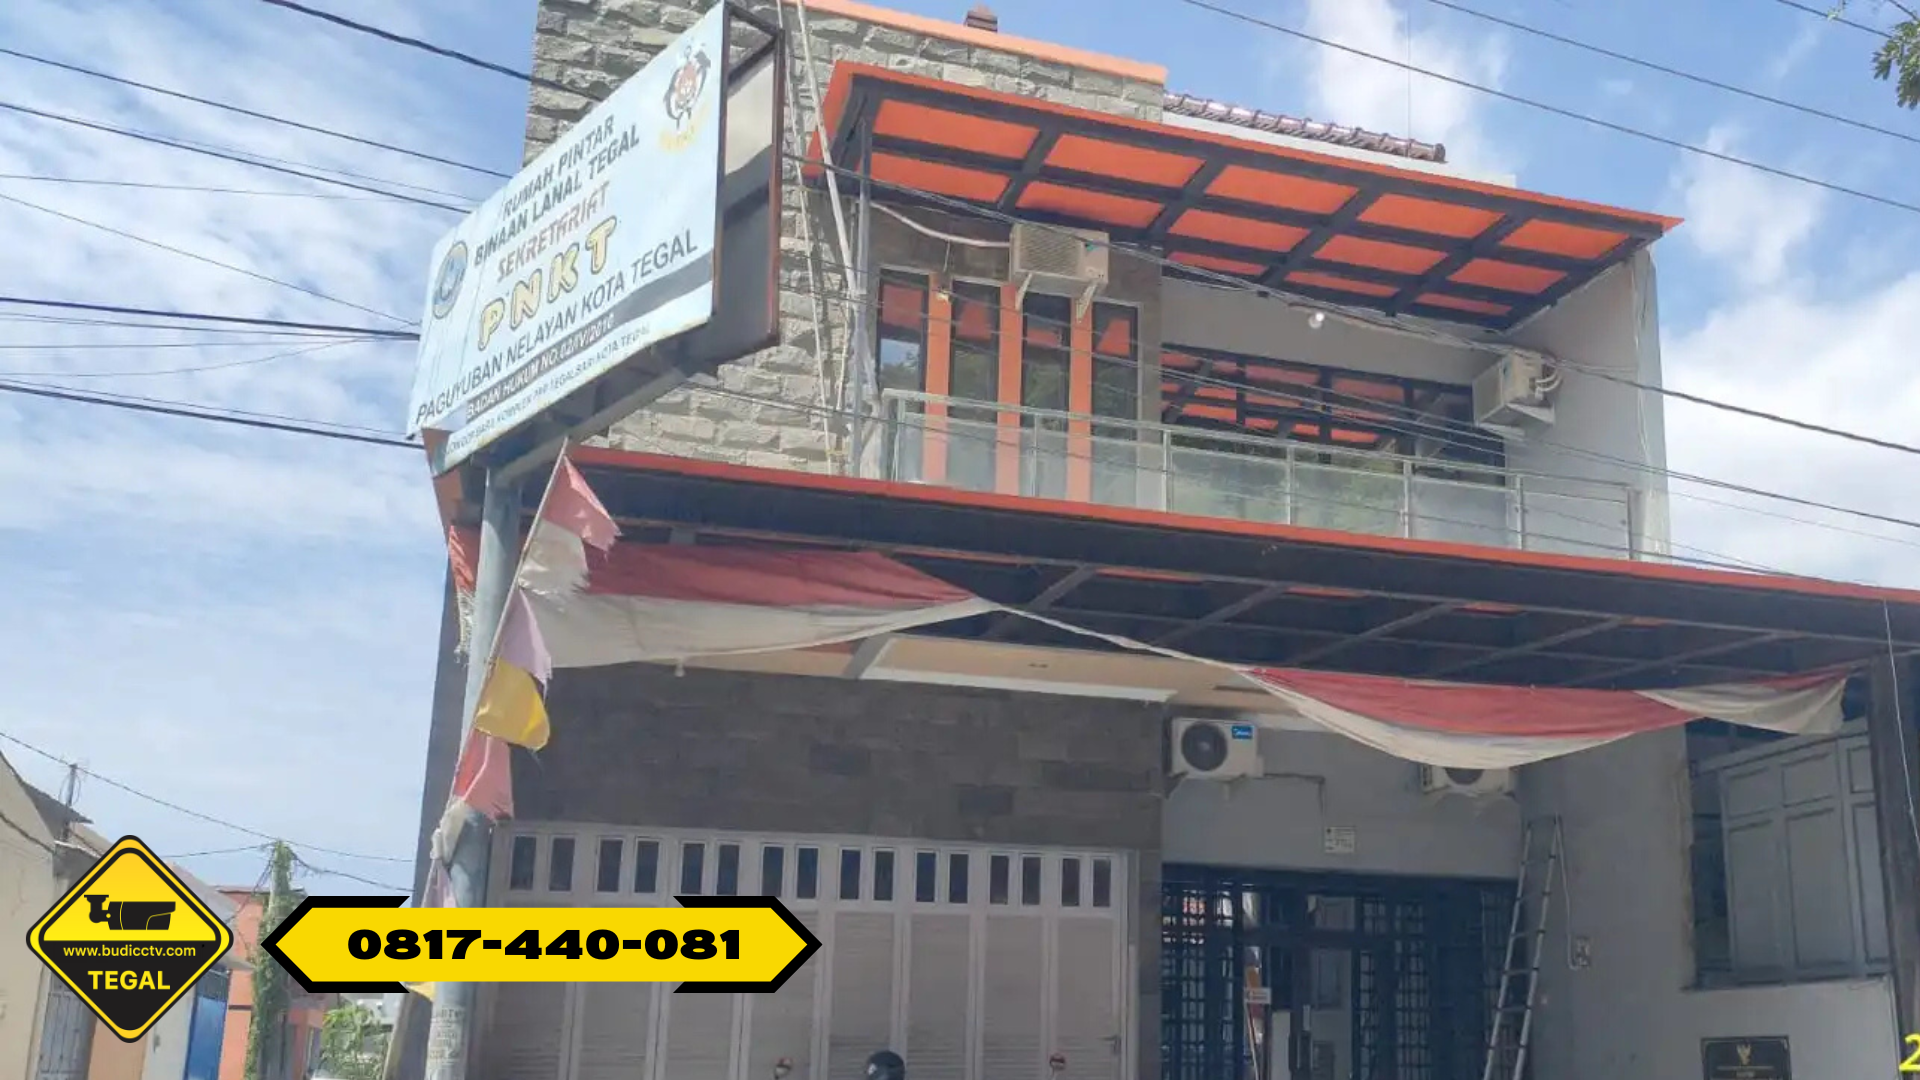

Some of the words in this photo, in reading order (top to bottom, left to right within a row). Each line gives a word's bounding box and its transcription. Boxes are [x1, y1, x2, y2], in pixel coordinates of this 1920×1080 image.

[475, 208, 528, 267] BINAAN
[532, 169, 582, 222] LANAL
[589, 124, 640, 180] TEGAL
[503, 164, 554, 221] RUMAH
[558, 114, 614, 176] PINTAR
[498, 180, 610, 283] SEKRETARIAT
[416, 351, 502, 424] PAGUYUBAN
[506, 301, 577, 367] NELAYAN
[581, 275, 625, 320] KOTA
[631, 229, 699, 284] TEGAL
[502, 360, 540, 399] HUKUM
